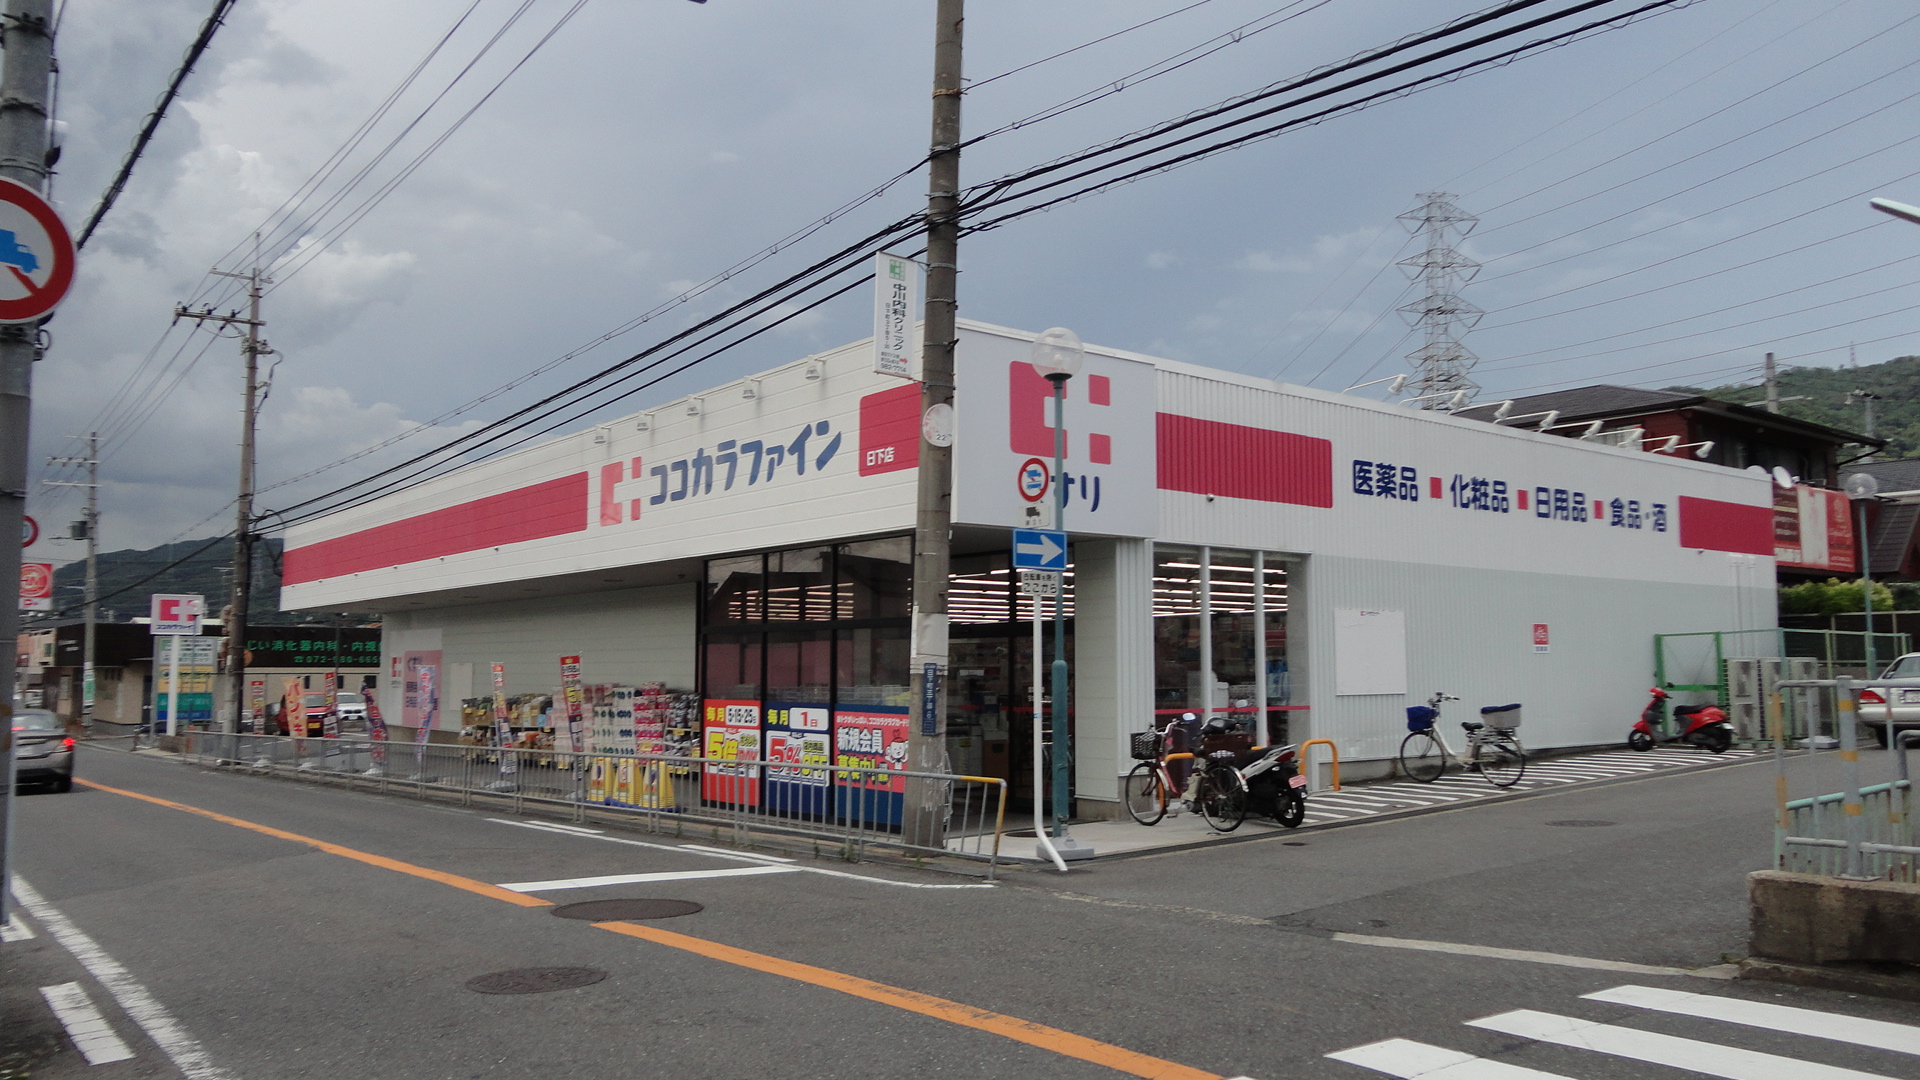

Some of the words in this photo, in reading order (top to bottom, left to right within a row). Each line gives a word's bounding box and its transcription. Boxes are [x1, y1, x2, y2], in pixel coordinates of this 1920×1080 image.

[892, 283, 907, 351] 中川内科クリニック
[650, 420, 842, 506] ココカラファイン
[865, 446, 895, 468] 日下店
[1352, 459, 1418, 502] 医薬品
[1450, 473, 1509, 513] 化粧品
[1535, 486, 1587, 523] 日用品
[1610, 497, 1668, 533] 食品・酒
[1023, 573, 1057, 582] 自転車を除く
[1023, 583, 1057, 594] ここから
[305, 655, 381, 663] 072-980-665
[706, 706, 725, 722] 毎月
[767, 709, 789, 726] 毎月
[800, 711, 818, 728] 1日
[707, 732, 739, 768] 5倍
[837, 726, 883, 753] 新規会員
[768, 736, 801, 775] 5%
[802, 754, 828, 778] OFF
